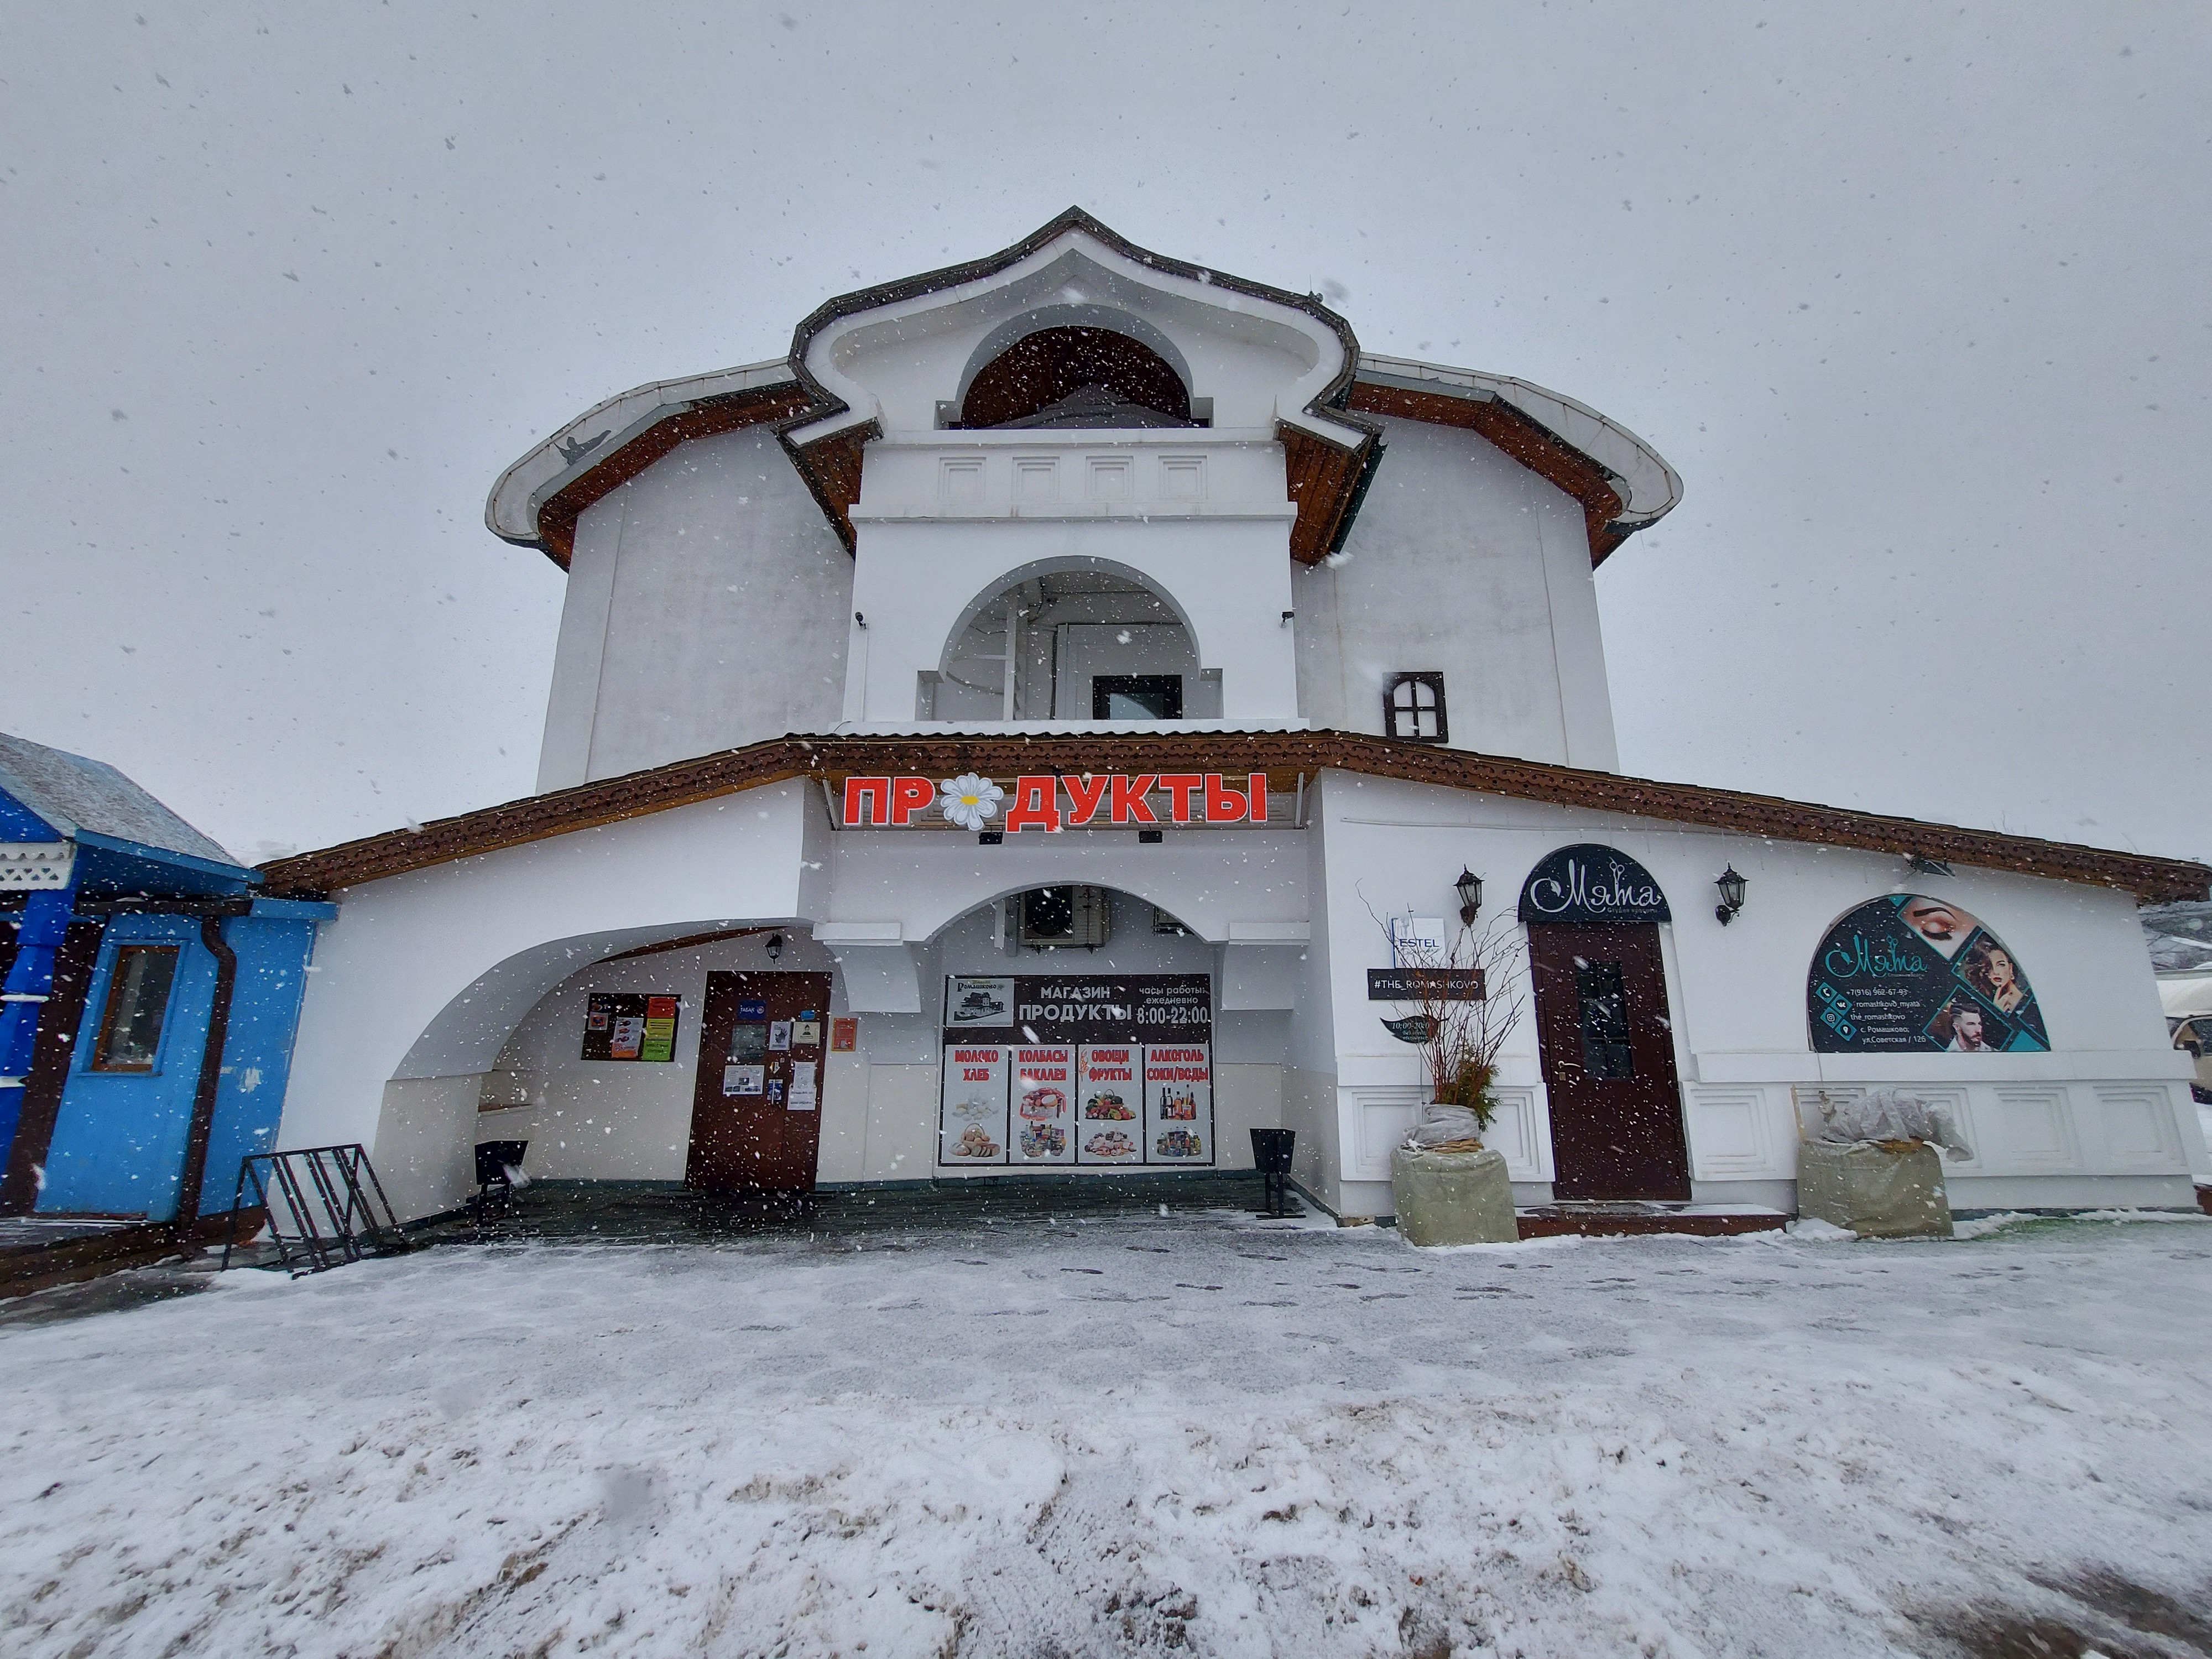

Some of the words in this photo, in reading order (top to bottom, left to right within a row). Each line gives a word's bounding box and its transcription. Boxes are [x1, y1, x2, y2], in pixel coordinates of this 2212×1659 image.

[1530, 857, 1662, 913] Мята
[1400, 938, 1439, 947] ESTEL
[1825, 933, 1928, 978] Мята
[957, 982, 997, 992] Ромашково
[1041, 987, 1110, 999] МАГАЗИН
[1146, 997, 1198, 1005] ежедневно
[1019, 1004, 1132, 1022] ПРОДУКТЫ
[1137, 1006, 1208, 1024] 8:00-22:00
[954, 1050, 999, 1062] МОЛОКО
[1019, 1050, 1068, 1062] КОЛБАСЫ
[1091, 1050, 1129, 1065] ОВОЩИ
[1150, 1049, 1204, 1062] АЛКОГОЛЬ
[963, 1068, 989, 1081] ХЛЕБ
[1020, 1068, 1067, 1081] БАКАЛЕЯ
[1089, 1067, 1132, 1082] ФРУКТЫ
[1146, 1066, 1208, 1082] СОКИ/ВОДЫ
